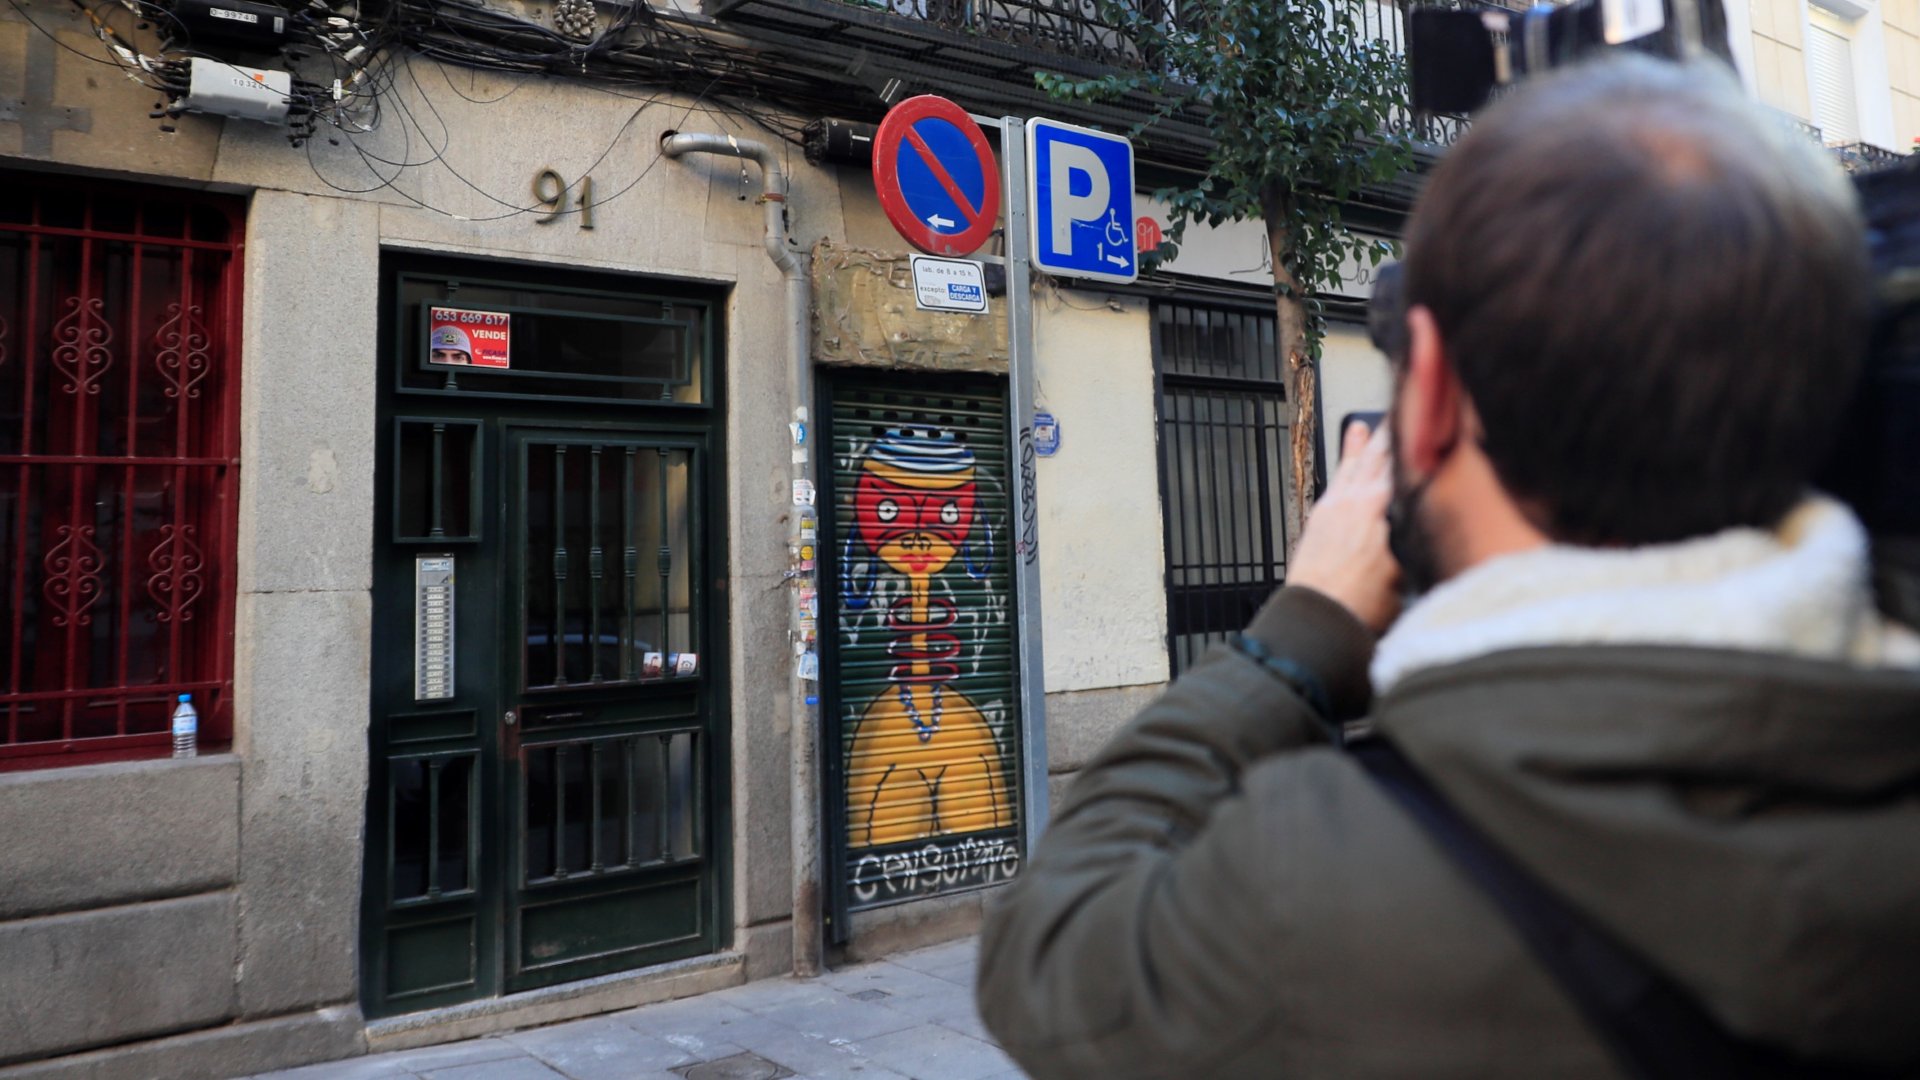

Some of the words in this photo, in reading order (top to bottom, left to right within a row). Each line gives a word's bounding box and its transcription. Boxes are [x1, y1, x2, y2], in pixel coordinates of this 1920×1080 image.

[532, 167, 594, 230] 91
[1049, 139, 1111, 256] P
[1097, 242, 1103, 261] 1
[951, 284, 972, 293] CARGA
[950, 292, 980, 301] DESCARGA
[435, 310, 457, 321] 653
[460, 312, 482, 324] 669
[485, 314, 506, 325] 617
[472, 329, 507, 340] VENDE
